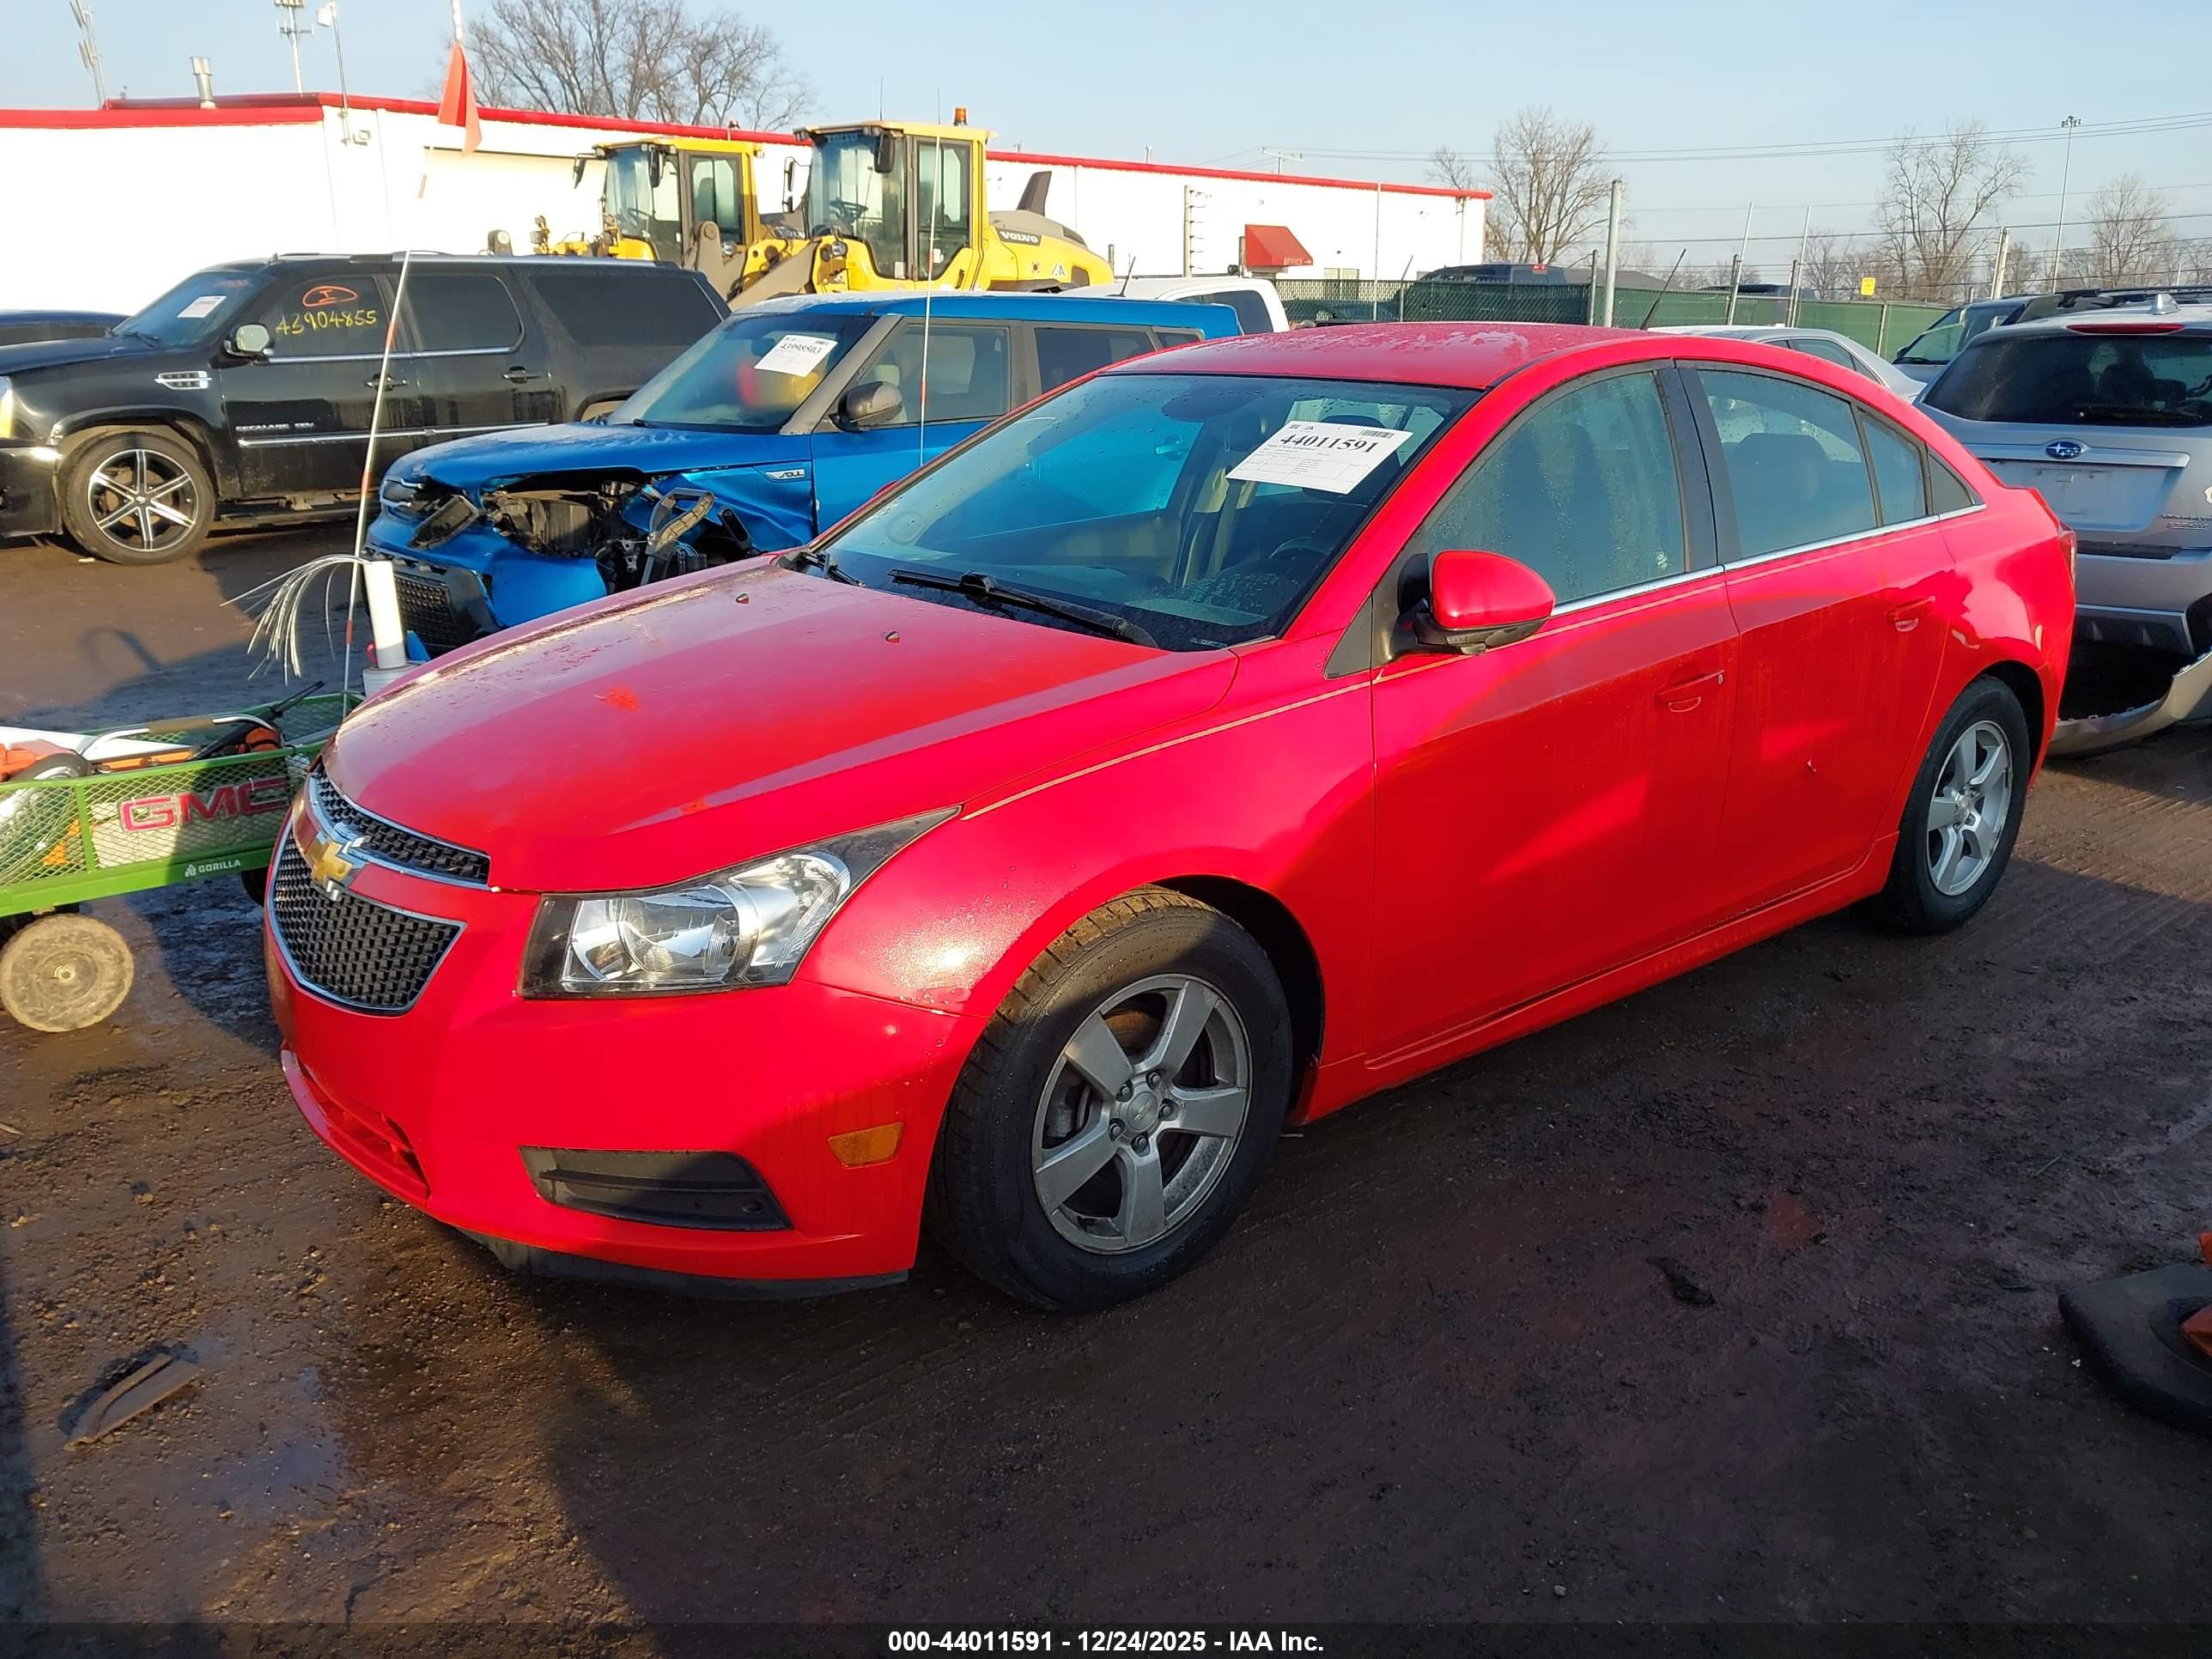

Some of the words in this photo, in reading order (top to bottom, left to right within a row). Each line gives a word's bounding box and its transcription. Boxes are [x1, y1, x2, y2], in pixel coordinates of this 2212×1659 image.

[1000, 229, 1039, 243] VOLVO
[1279, 434, 1379, 453] 44011591
[118, 775, 291, 833] GMC
[198, 860, 241, 873] GORILLA
